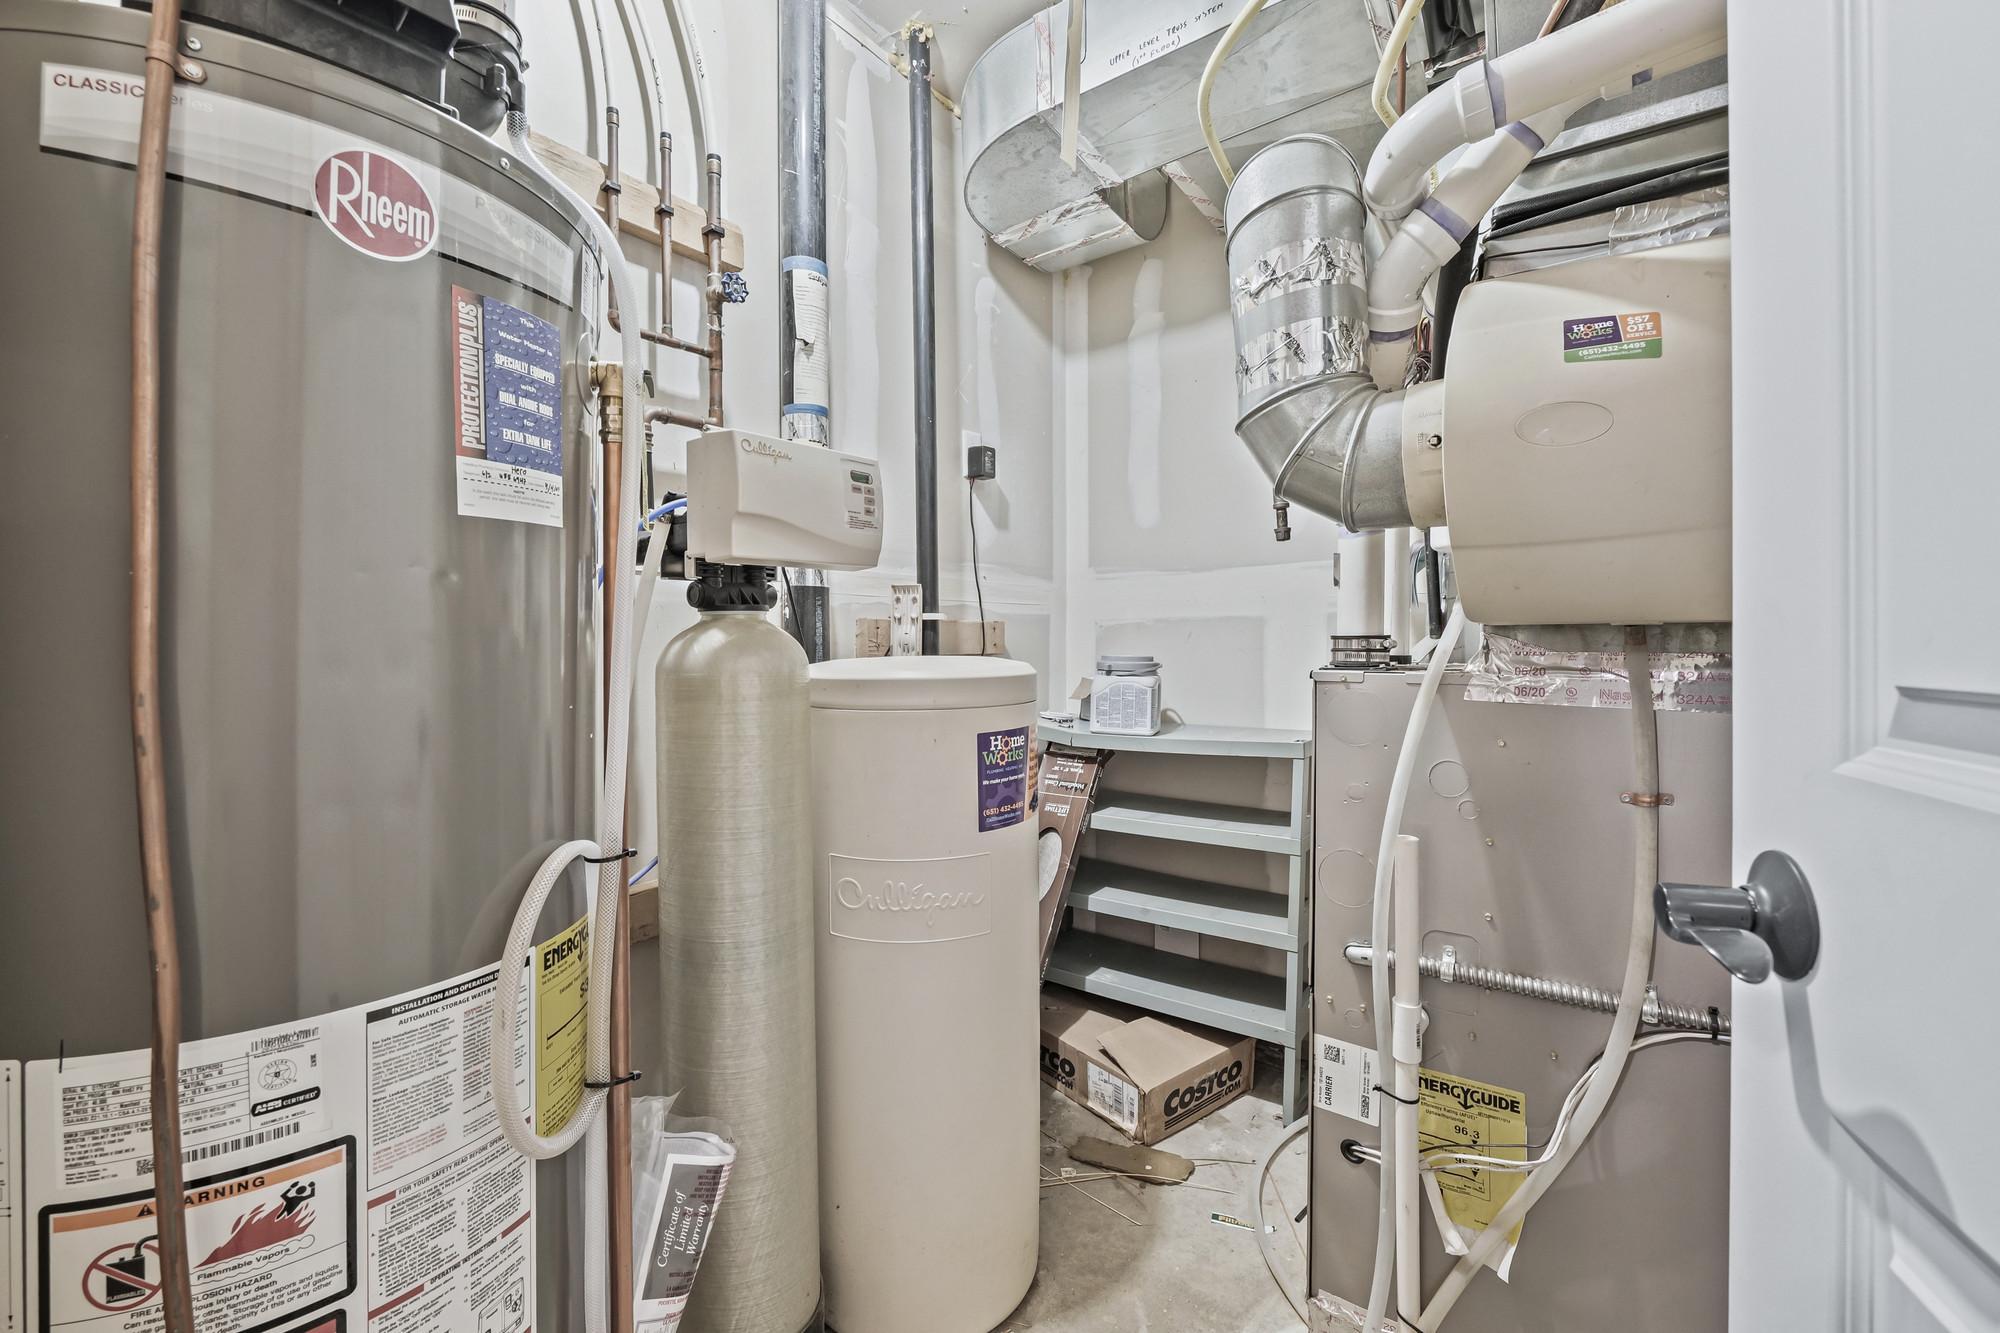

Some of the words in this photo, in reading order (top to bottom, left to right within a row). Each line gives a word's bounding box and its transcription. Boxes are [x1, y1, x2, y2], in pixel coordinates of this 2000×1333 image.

[1110, 50, 1130, 66] UPPER
[1139, 35, 1160, 50] LEVEL
[1194, 2, 1224, 23] SYSTEM
[53, 73, 145, 98] CLASSIC
[329, 152, 430, 243] Rheem
[1567, 327, 1613, 340] Works
[1572, 321, 1614, 332] Home
[1626, 322, 1654, 332] OFF
[1627, 315, 1650, 324] $57
[498, 330, 522, 343] Water
[494, 352, 529, 374] SPECIALLY
[530, 364, 555, 384] EQUIPPED
[499, 391, 517, 406] DUAL
[520, 384, 537, 393] with
[523, 419, 535, 427] for
[502, 429, 523, 444] EXTRA
[523, 433, 540, 448] TANK
[541, 437, 552, 450] LIFE
[740, 438, 793, 464] Culligan
[1515, 667, 1546, 676] 06/20
[1514, 687, 1545, 697] 06/20
[1677, 695, 1715, 705] 324A
[982, 748, 1024, 766] Works
[990, 735, 1025, 751] Home
[837, 877, 985, 926] Culligan
[391, 993, 443, 1015] INSTALLATION
[444, 987, 459, 998] AND
[460, 976, 493, 992] OPERATION
[398, 1008, 439, 1026] AUTOMATIC
[441, 996, 470, 1011] STORAGE
[471, 988, 491, 1000] WATER
[1164, 1059, 1243, 1117] COSTCO
[1222, 1080, 1242, 1098] .COM
[1324, 1075, 1333, 1106] CARRIER
[1419, 1076, 1520, 1114] NERGYGUIDE
[1454, 1125, 1480, 1139] 96.3
[398, 1185, 412, 1195] FOR
[413, 1176, 430, 1188] YOUR
[431, 1165, 452, 1179] SAFETY
[454, 1157, 468, 1168] READ
[469, 1147, 487, 1160] BEFORE
[488, 1135, 504, 1147] OPERA
[184, 1176, 266, 1207] ARNING
[657, 1205, 681, 1268] Certificate
[675, 1189, 687, 1205] of
[674, 1206, 694, 1252] Limited
[686, 1202, 709, 1256] Warranty
[197, 1257, 253, 1281] Flammable
[255, 1247, 290, 1263] Vapors
[430, 1262, 461, 1284] OPERATING
[462, 1236, 497, 1264] INSTRUCTIONS
[123, 1321, 141, 1330] Can
[143, 1316, 164, 1326] resu
[216, 1293, 240, 1306] injury
[254, 1280, 278, 1293] death
[130, 1309, 152, 1319] FIRE
[234, 1273, 273, 1290] HAZARD
[203, 1308, 224, 1318] other
[226, 1291, 268, 1310] flammable
[271, 1282, 297, 1298] vapors
[299, 1274, 313, 1284] and
[315, 1263, 339, 1277] liquids
[214, 1320, 228, 1329] the
[231, 1309, 258, 1324] vicinity
[261, 1305, 269, 1313] of
[271, 1300, 285, 1310] this
[297, 1290, 310, 1299] any
[313, 1281, 332, 1292] other
[233, 1300, 265, 1315] Storage
[267, 1296, 275, 1304] of
[287, 1287, 301, 1296] use
[302, 1281, 311, 1290] of
[313, 1269, 343, 1286] gasoline
